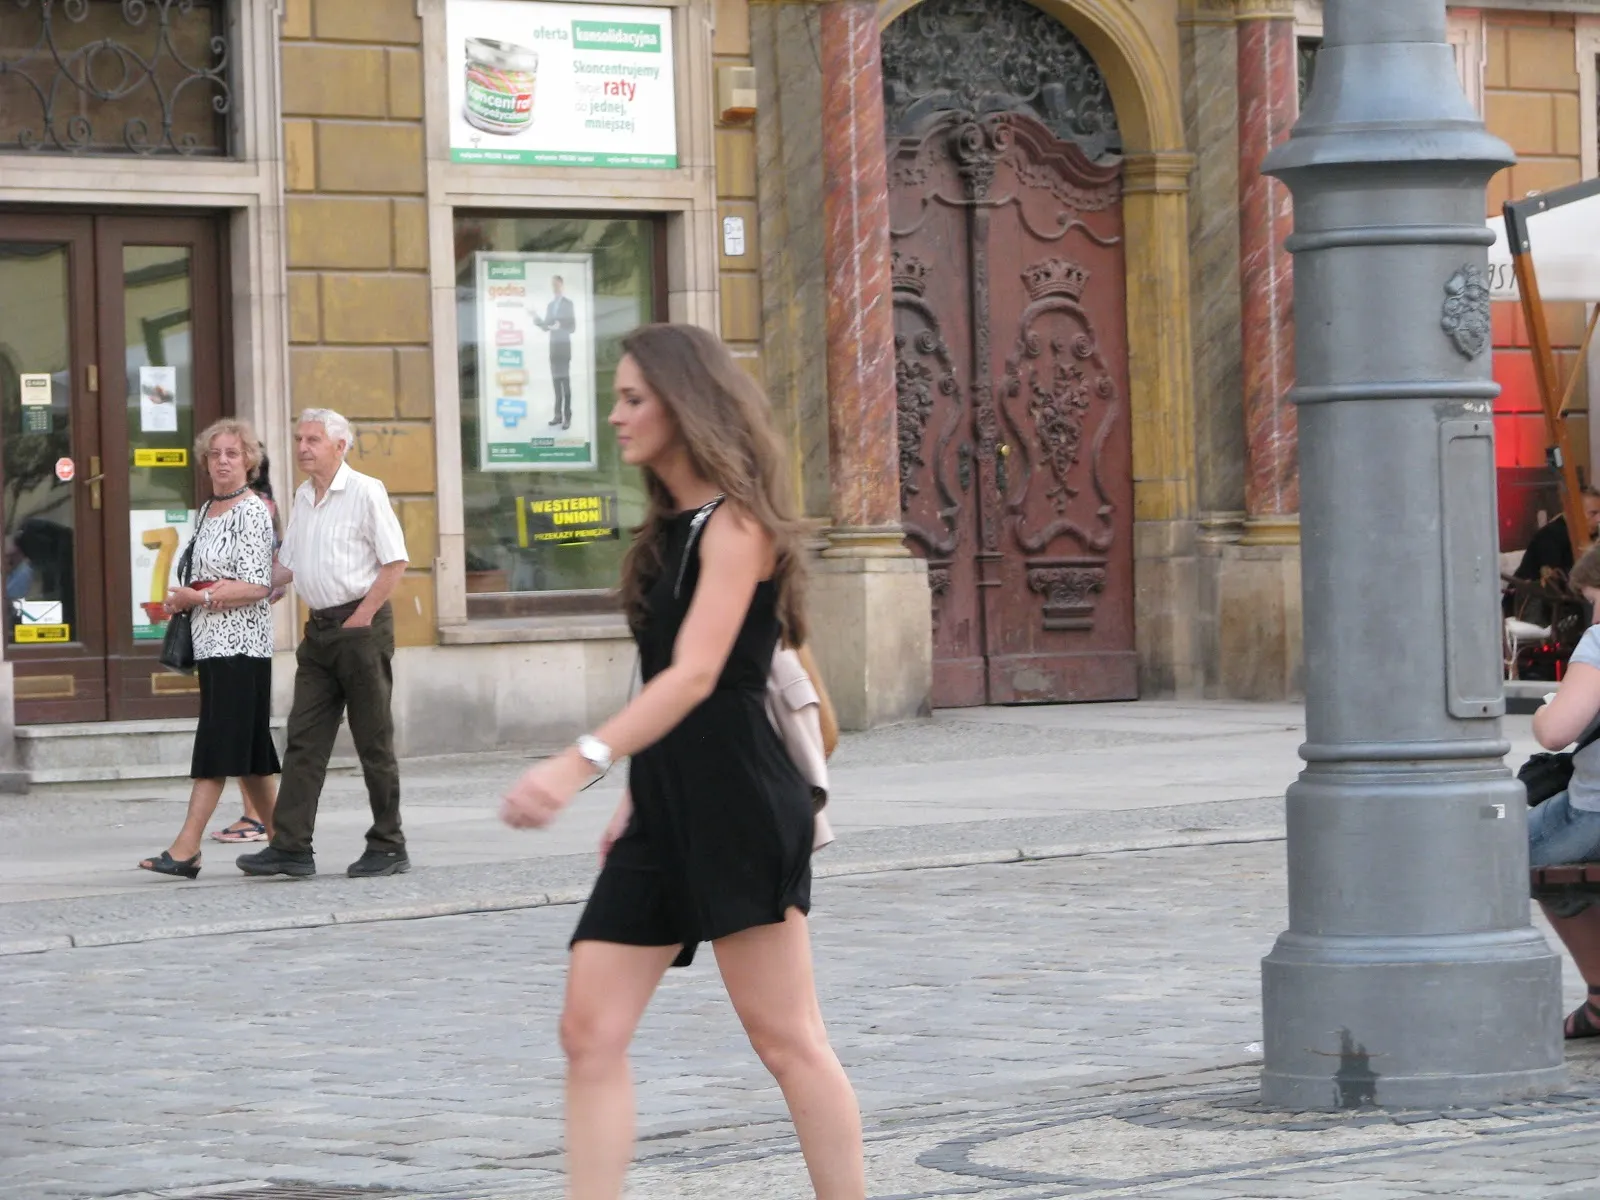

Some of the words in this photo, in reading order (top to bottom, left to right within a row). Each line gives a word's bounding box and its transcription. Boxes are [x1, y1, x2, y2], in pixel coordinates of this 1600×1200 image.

[533, 26, 569, 40] oferta
[573, 60, 660, 79] Skoncentrujemy
[603, 78, 636, 101] raty
[585, 116, 635, 134] mniejszej
[530, 496, 602, 514] WESTERN
[553, 509, 602, 525] UNION
[142, 526, 179, 604] 7
